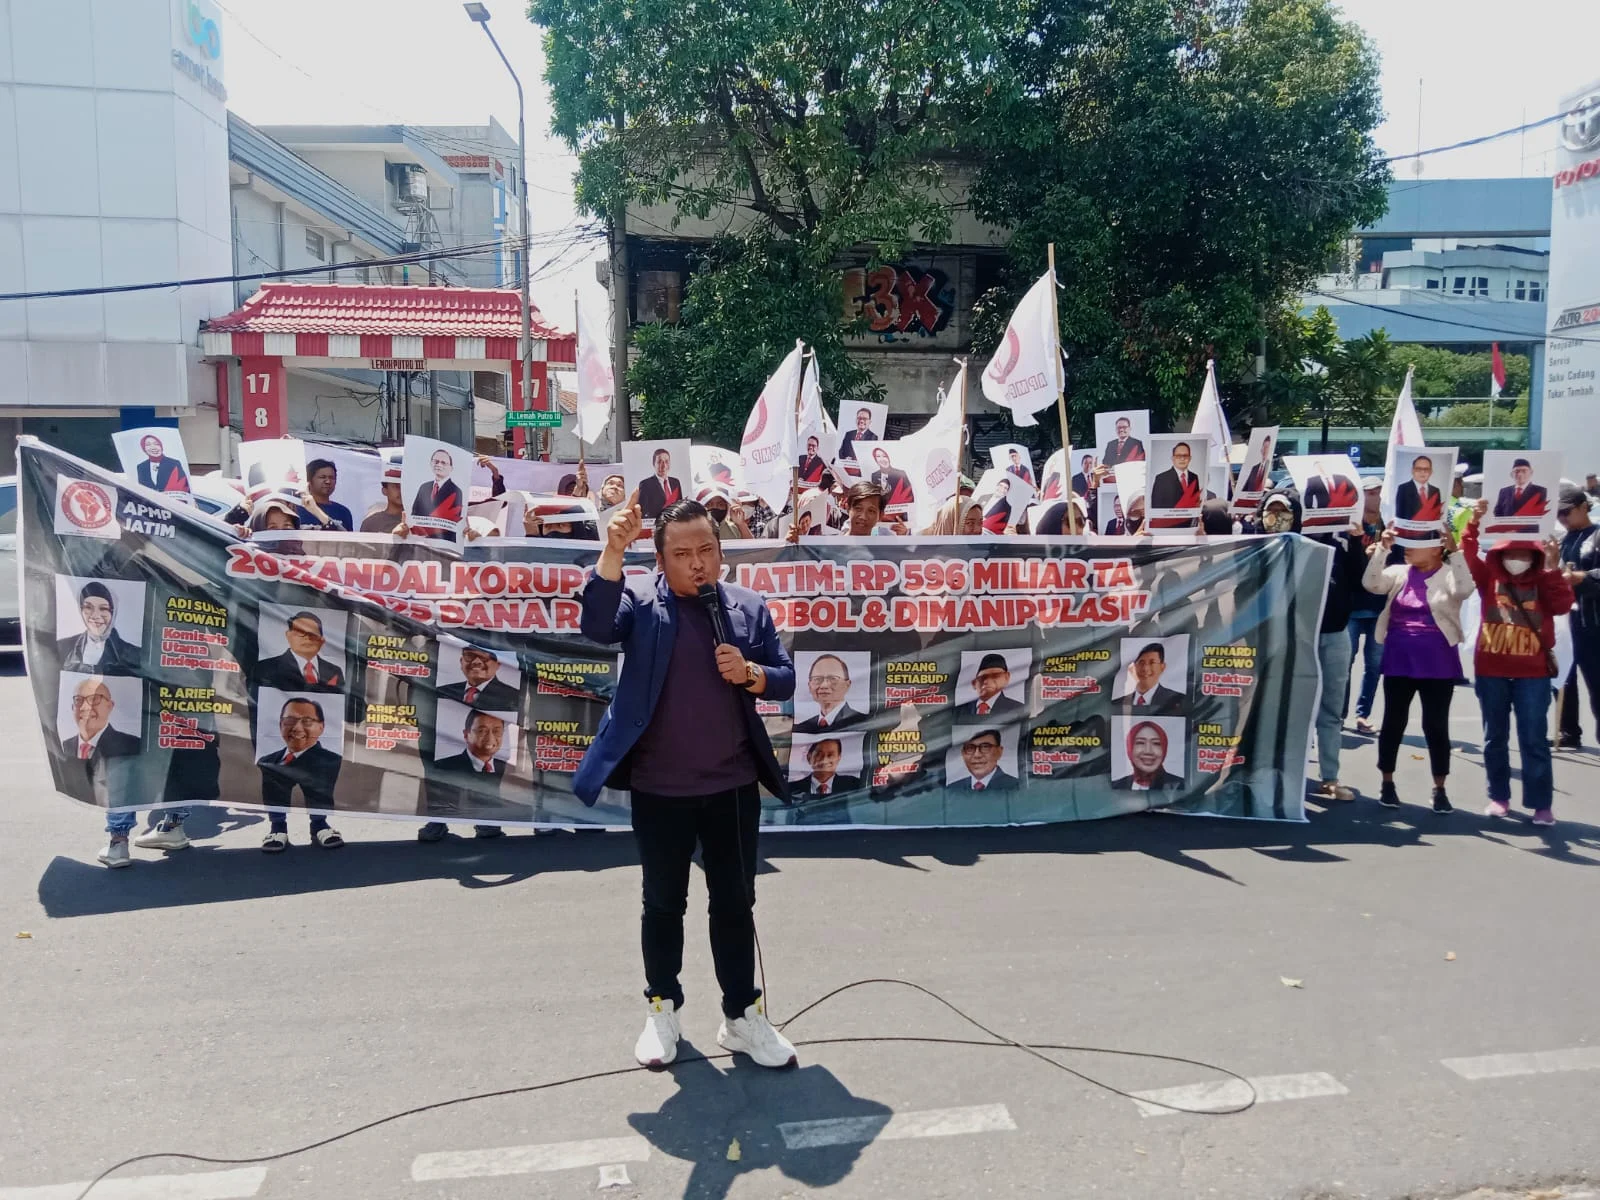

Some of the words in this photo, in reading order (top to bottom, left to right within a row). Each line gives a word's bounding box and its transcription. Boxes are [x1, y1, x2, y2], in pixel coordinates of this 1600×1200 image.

[1554, 158, 1600, 189] TOYO
[1567, 369, 1596, 381] Cadang
[246, 373, 271, 394] 17
[1567, 385, 1595, 397] Tambah
[255, 407, 269, 428] 8
[517, 411, 536, 420] Lemah
[537, 411, 554, 420] Putro
[1350, 446, 1359, 456] P
[122, 500, 172, 521] APMP
[123, 517, 176, 539] JATIM
[851, 562, 896, 591] RP
[903, 562, 966, 591] 596
[973, 561, 1088, 590] MILIAR
[1093, 561, 1135, 588] TA
[167, 597, 192, 610] ADI
[440, 602, 549, 629] DANA
[862, 600, 887, 628] &
[894, 594, 1148, 628] DIMANIPULASI"
[166, 610, 226, 628] TYOWATI
[163, 627, 228, 646] Komisaris
[367, 635, 406, 648] ADHY
[162, 640, 208, 656] Utama
[1203, 646, 1257, 657] WINARDI
[367, 647, 429, 662] KARYONO
[161, 654, 240, 671] Independen
[535, 662, 610, 674] MUHAMMAD
[886, 662, 937, 672] DADANG
[1045, 662, 1076, 672] ASIH
[1202, 658, 1254, 669] LEGOWO
[1041, 676, 1097, 688] Komisaris
[160, 687, 172, 698] R.
[174, 687, 216, 699] ARIEF
[1202, 684, 1242, 696] Utama
[160, 700, 233, 714] WICAKSON
[366, 704, 396, 715] ARIF
[397, 705, 416, 716] SU
[366, 713, 417, 726] HIRMAN
[536, 721, 579, 732] TONNY
[1034, 726, 1072, 736] ANDRY
[1199, 724, 1222, 734] UMI
[366, 727, 421, 740] Direktur
[879, 731, 920, 742] WAHYU
[159, 736, 206, 749] Utama
[1033, 736, 1101, 746] WICAKSONO
[1198, 736, 1242, 746] RODIY
[877, 743, 926, 753] KUSUMO
[1032, 751, 1080, 763] Direktur
[535, 760, 579, 772] Syariah
